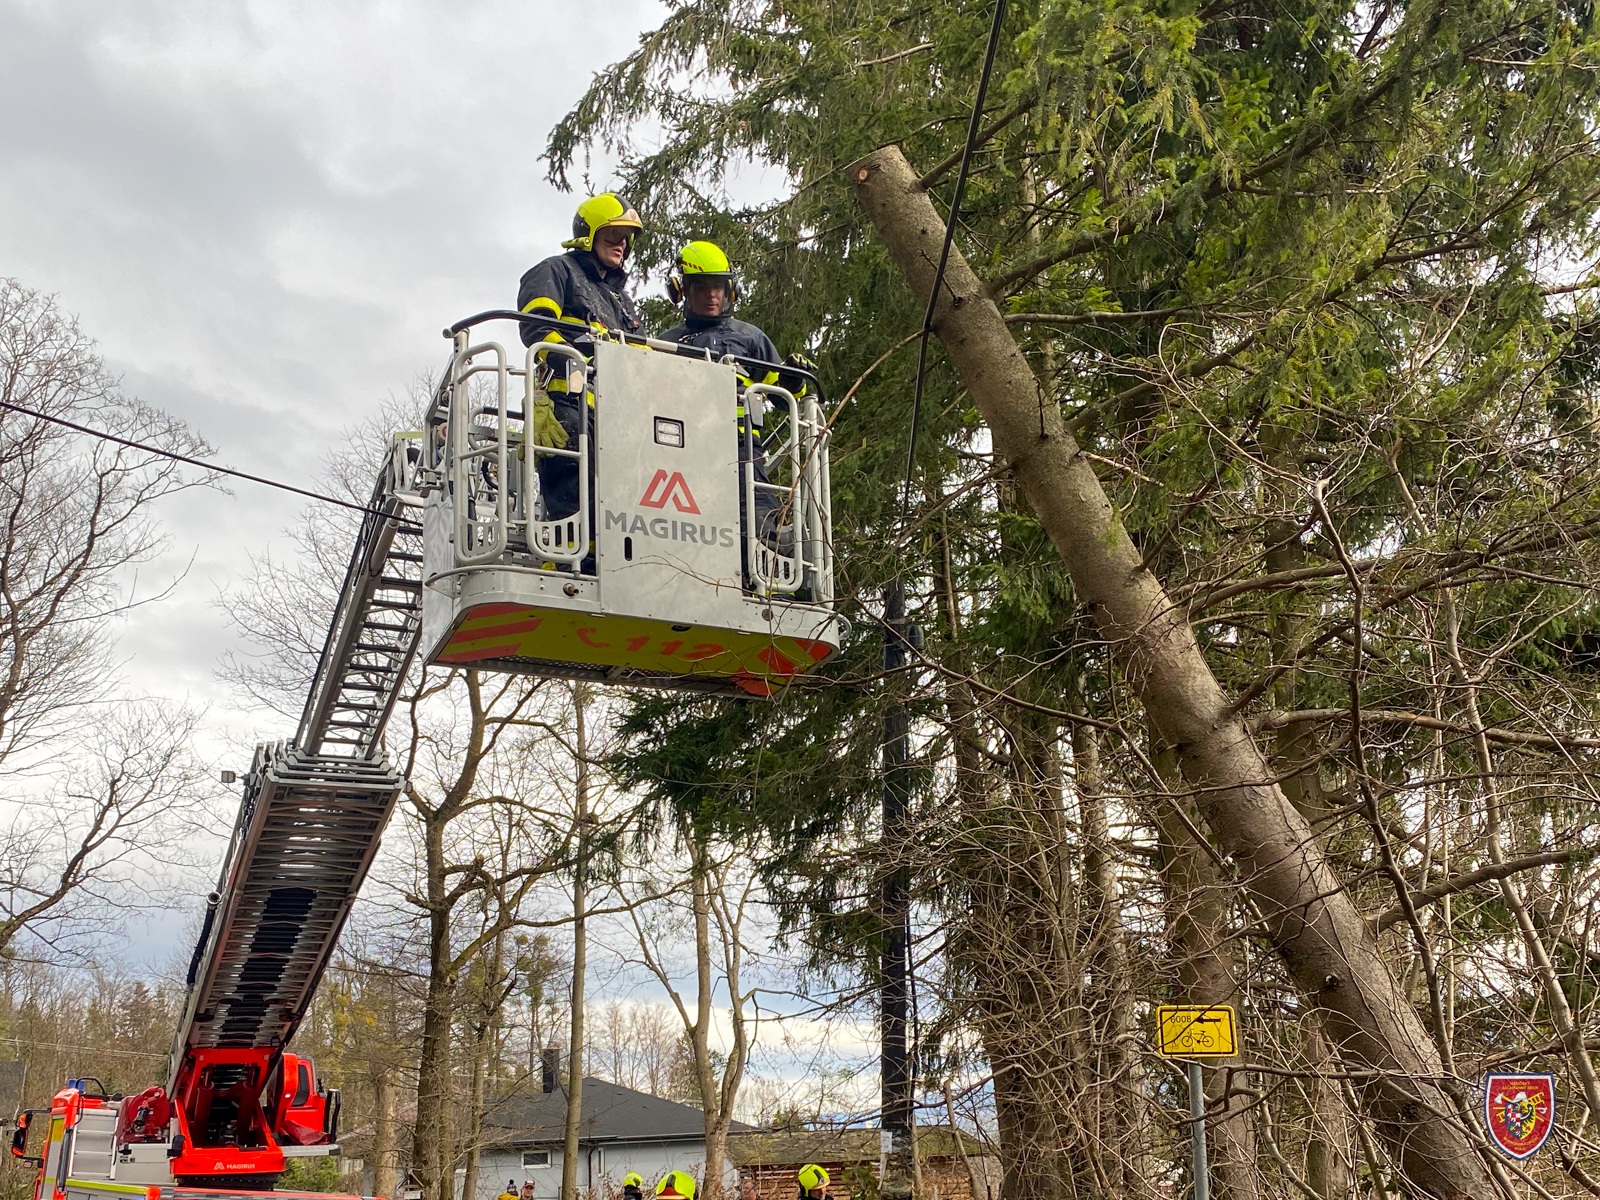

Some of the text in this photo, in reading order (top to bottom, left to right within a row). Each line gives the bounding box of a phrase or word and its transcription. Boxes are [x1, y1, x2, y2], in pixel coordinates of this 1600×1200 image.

[605, 509, 735, 548] MAGIRUS
[625, 635, 724, 660] 112
[1170, 1015, 1192, 1023] 6008
